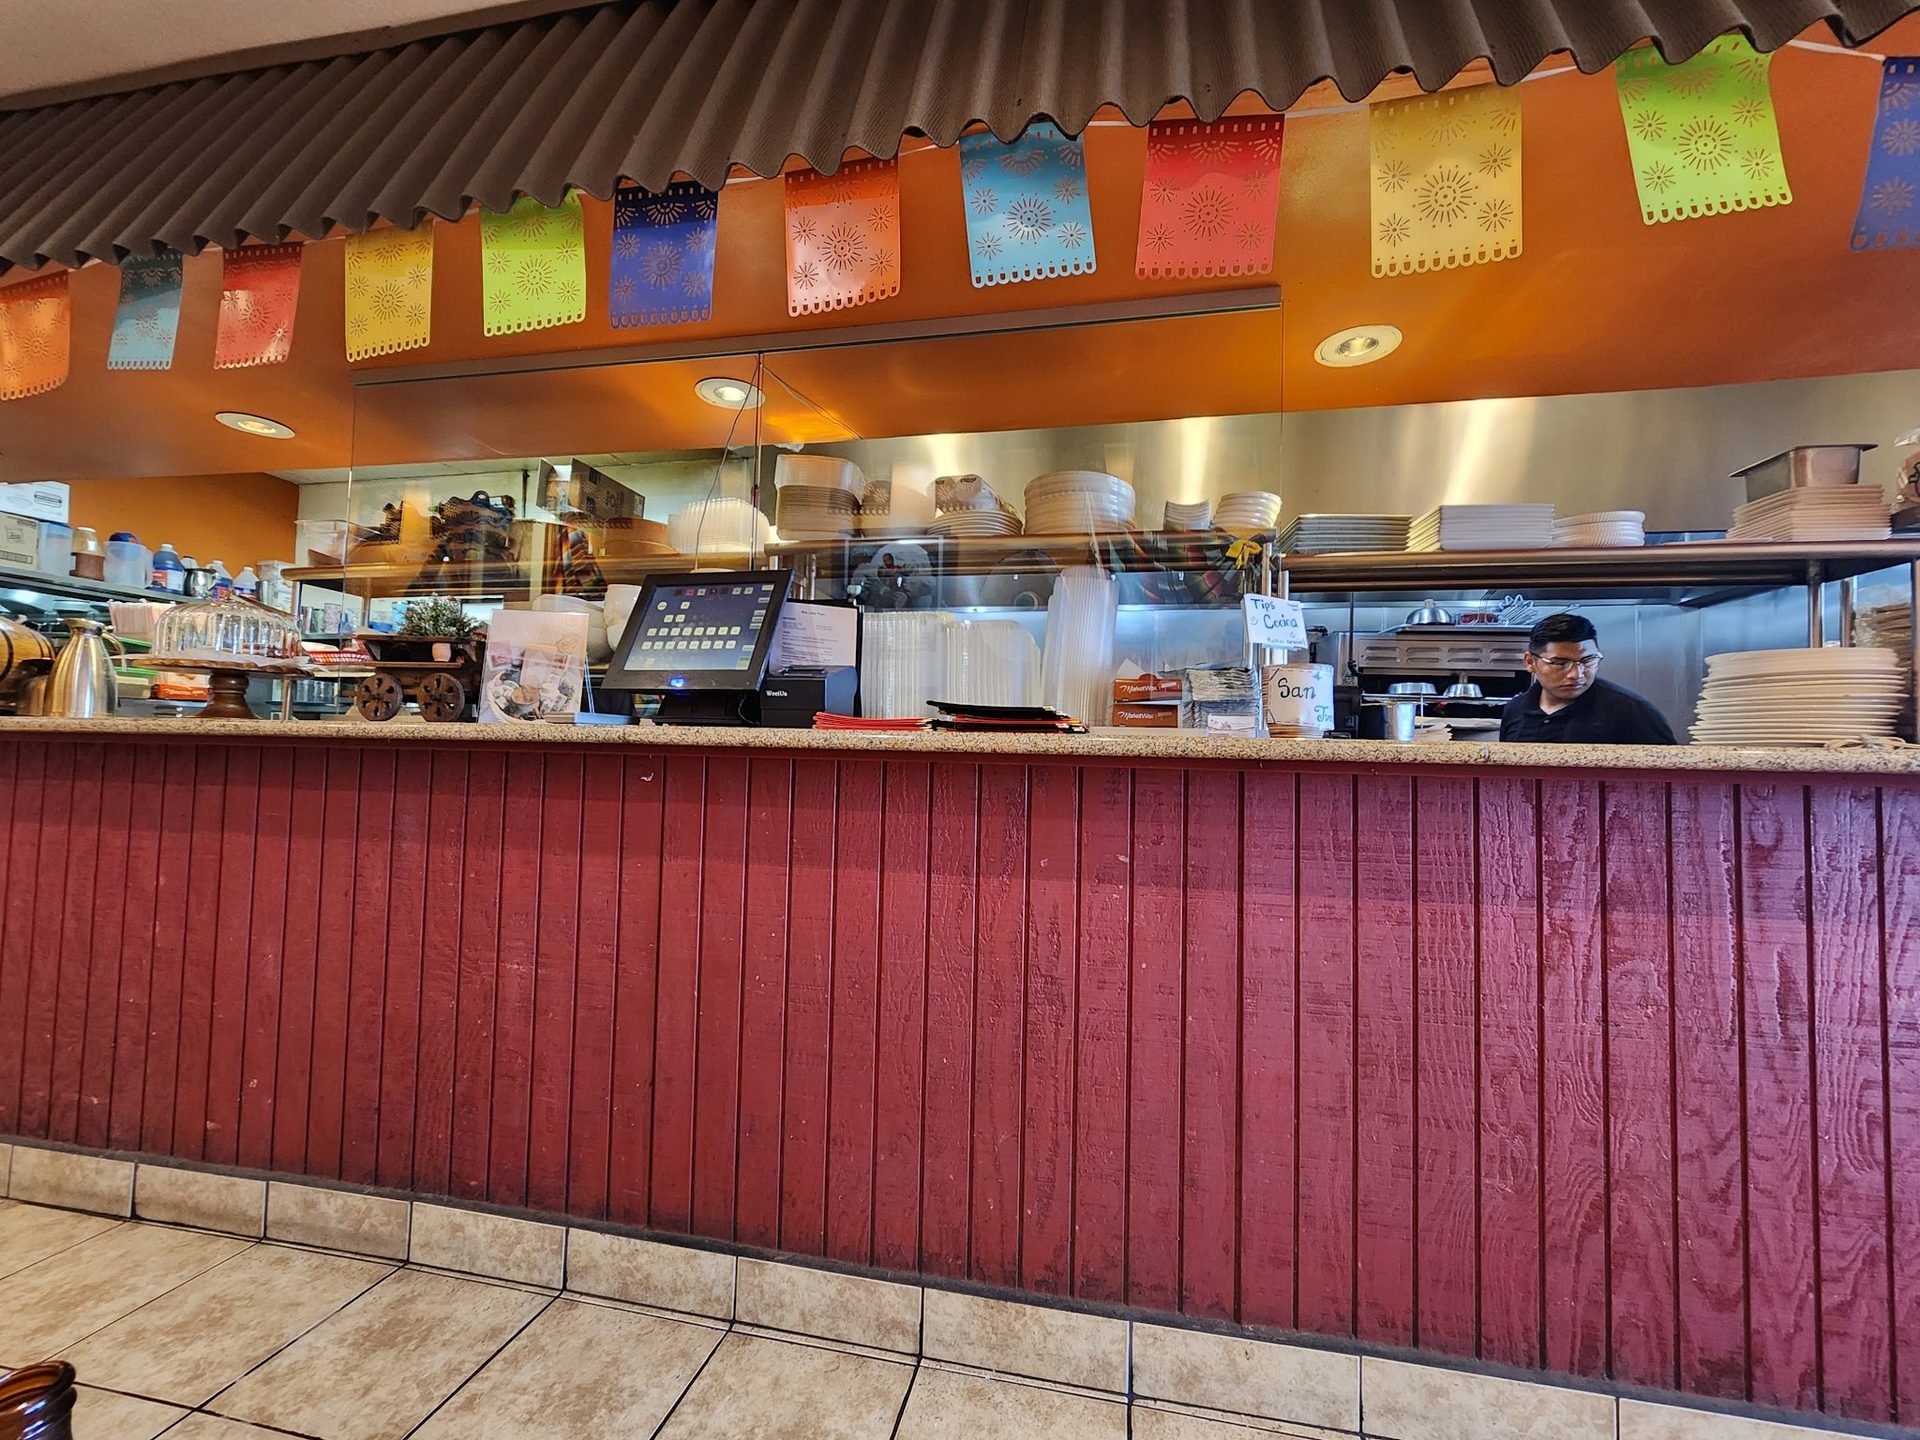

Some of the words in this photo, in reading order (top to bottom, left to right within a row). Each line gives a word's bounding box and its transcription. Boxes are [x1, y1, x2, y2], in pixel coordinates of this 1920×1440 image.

[1250, 598, 1276, 612] Tips
[1263, 614, 1298, 629] Cocina
[1277, 677, 1316, 699] San
